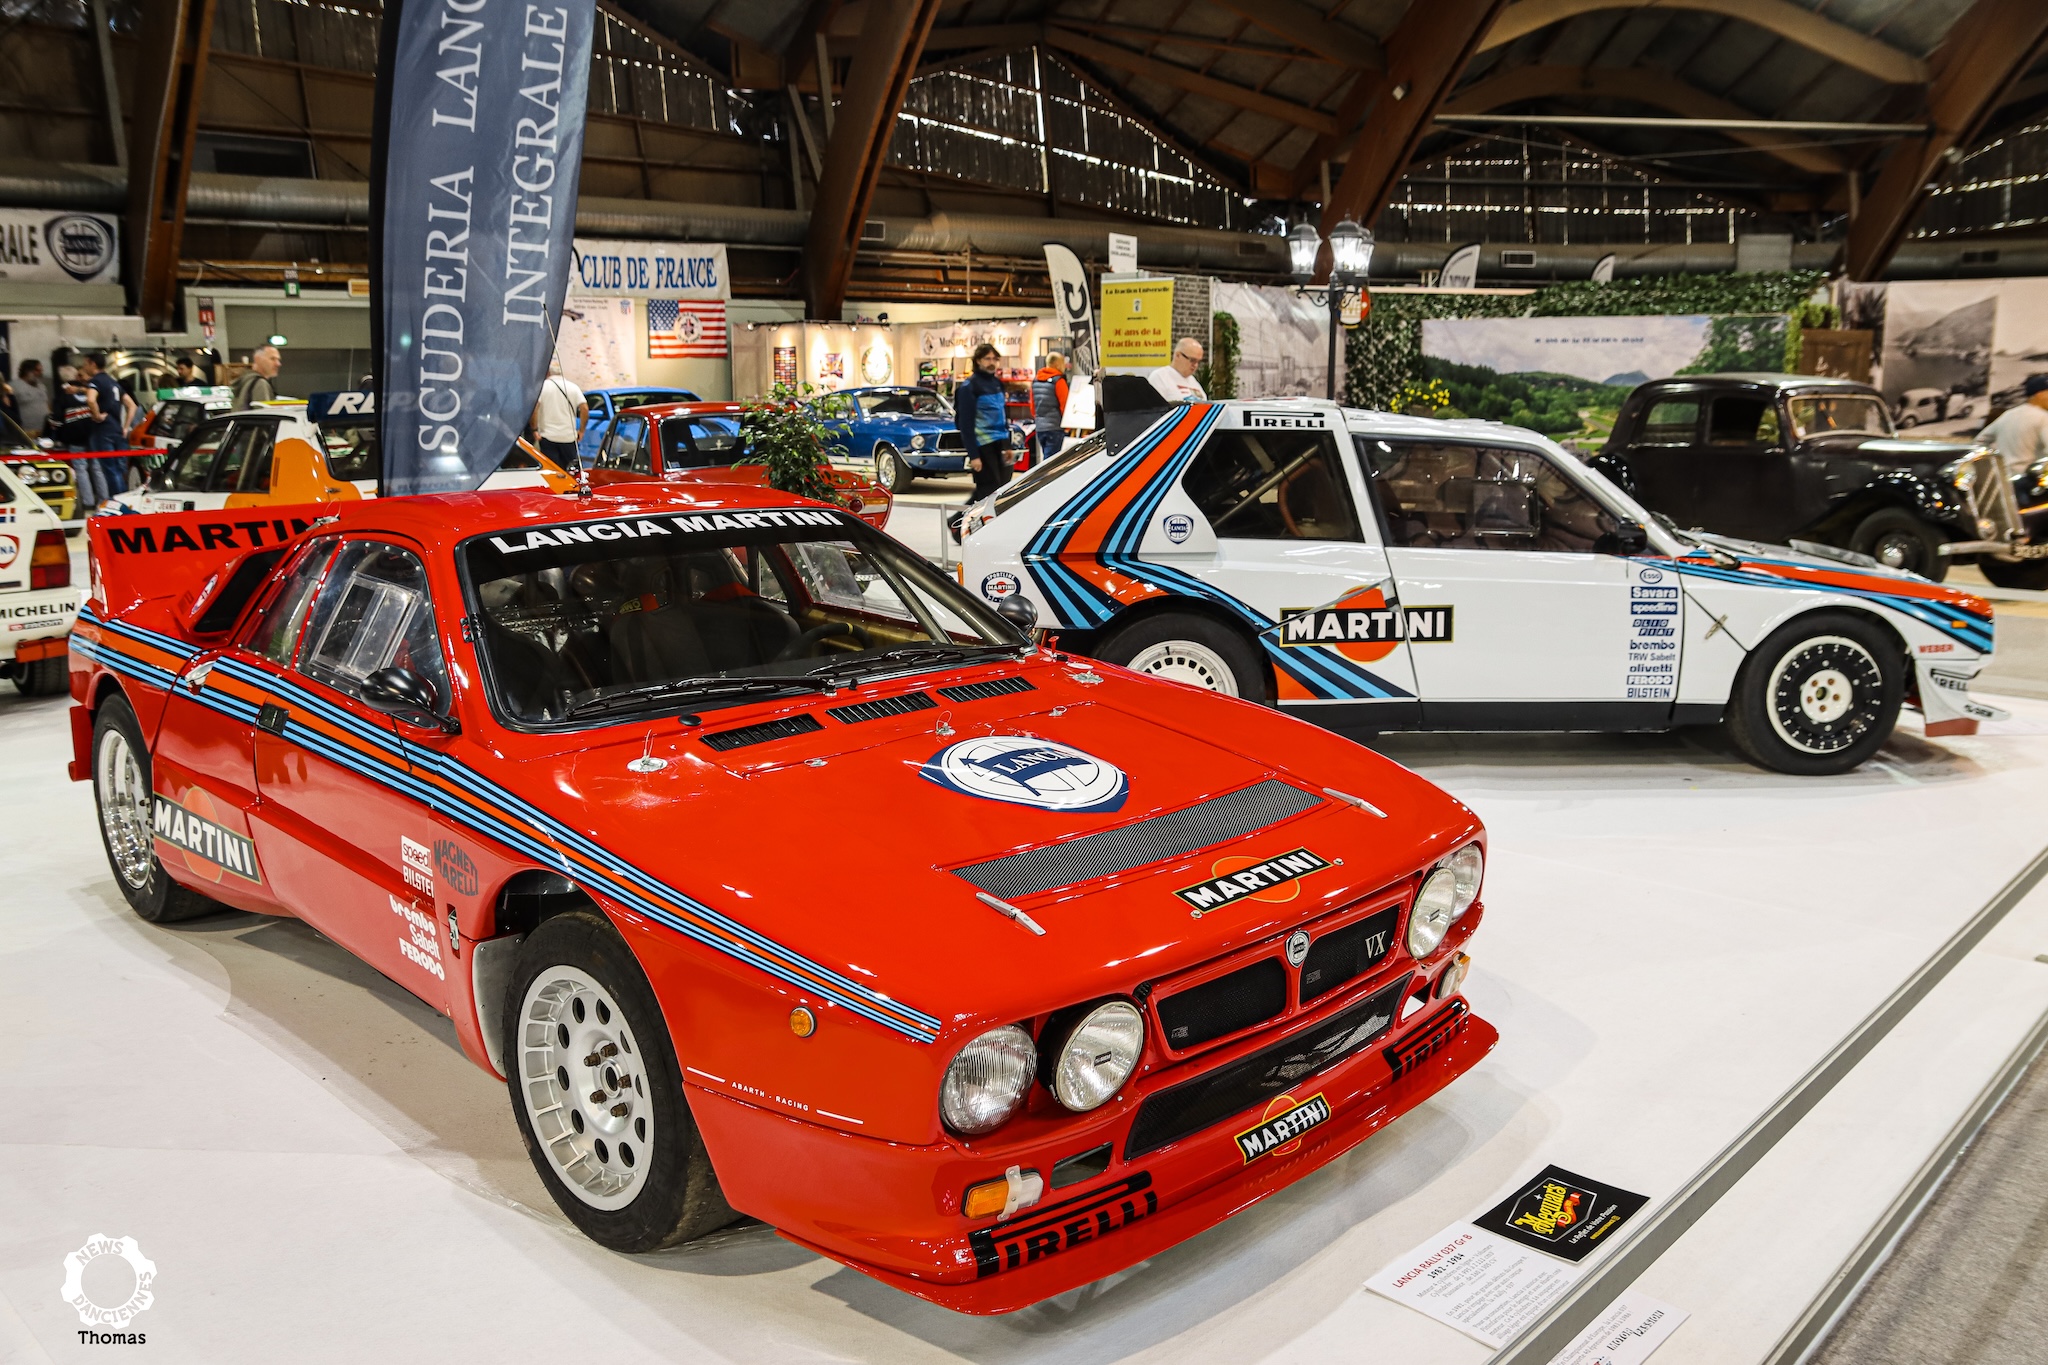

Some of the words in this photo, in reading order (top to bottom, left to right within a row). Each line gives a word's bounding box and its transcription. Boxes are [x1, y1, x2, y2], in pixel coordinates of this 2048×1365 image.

[502, 4, 568, 329] INTEGRALE
[581, 255, 622, 289] CLUB
[627, 256, 650, 289] DE
[655, 257, 717, 289] FRANCE
[418, 165, 474, 452] SCUDERIA
[940, 337, 969, 348] Mustang
[970, 335, 985, 346] Club
[998, 335, 1021, 345] France
[1107, 340, 1140, 348] Traction
[1243, 410, 1325, 428] PIRELLI
[489, 520, 672, 554] LANCIA
[671, 511, 844, 534] MARTINI
[986, 571, 1015, 581] SPORTLINE
[1643, 571, 1660, 579] Esso
[1632, 586, 1676, 598] Savara
[1632, 603, 1676, 613] speedline
[1288, 611, 1445, 641] MARTINI
[1633, 619, 1669, 627] OLIO
[1638, 628, 1674, 636] FIAT
[1628, 653, 1648, 661] TRW
[1650, 653, 1676, 661] Sabelt
[1630, 640, 1675, 650] brembo
[1627, 676, 1672, 685] FERODO
[1629, 664, 1672, 673] olivetti
[1627, 687, 1670, 698] BILSTEIN
[994, 749, 1076, 774] LANCIA
[155, 799, 253, 876] MARTINI
[1184, 852, 1324, 908] MARTINI
[389, 894, 436, 936] brembo
[409, 923, 442, 961] Sabelt
[1364, 930, 1387, 959] VX
[399, 937, 445, 981] FERODO
[731, 1081, 765, 1098] ABARTH
[775, 1095, 809, 1112] RACING
[1243, 1100, 1327, 1158] MARTINI
[1600, 1204, 1618, 1219] Passion
[968, 1170, 1158, 1279] PIRELLI
[1392, 1268, 1423, 1288] LANCIA
[1418, 1252, 1443, 1269] RALLY
[1440, 1243, 1456, 1255] 037
[1427, 1266, 1446, 1279] 1982
[1446, 1253, 1464, 1265] 1984
